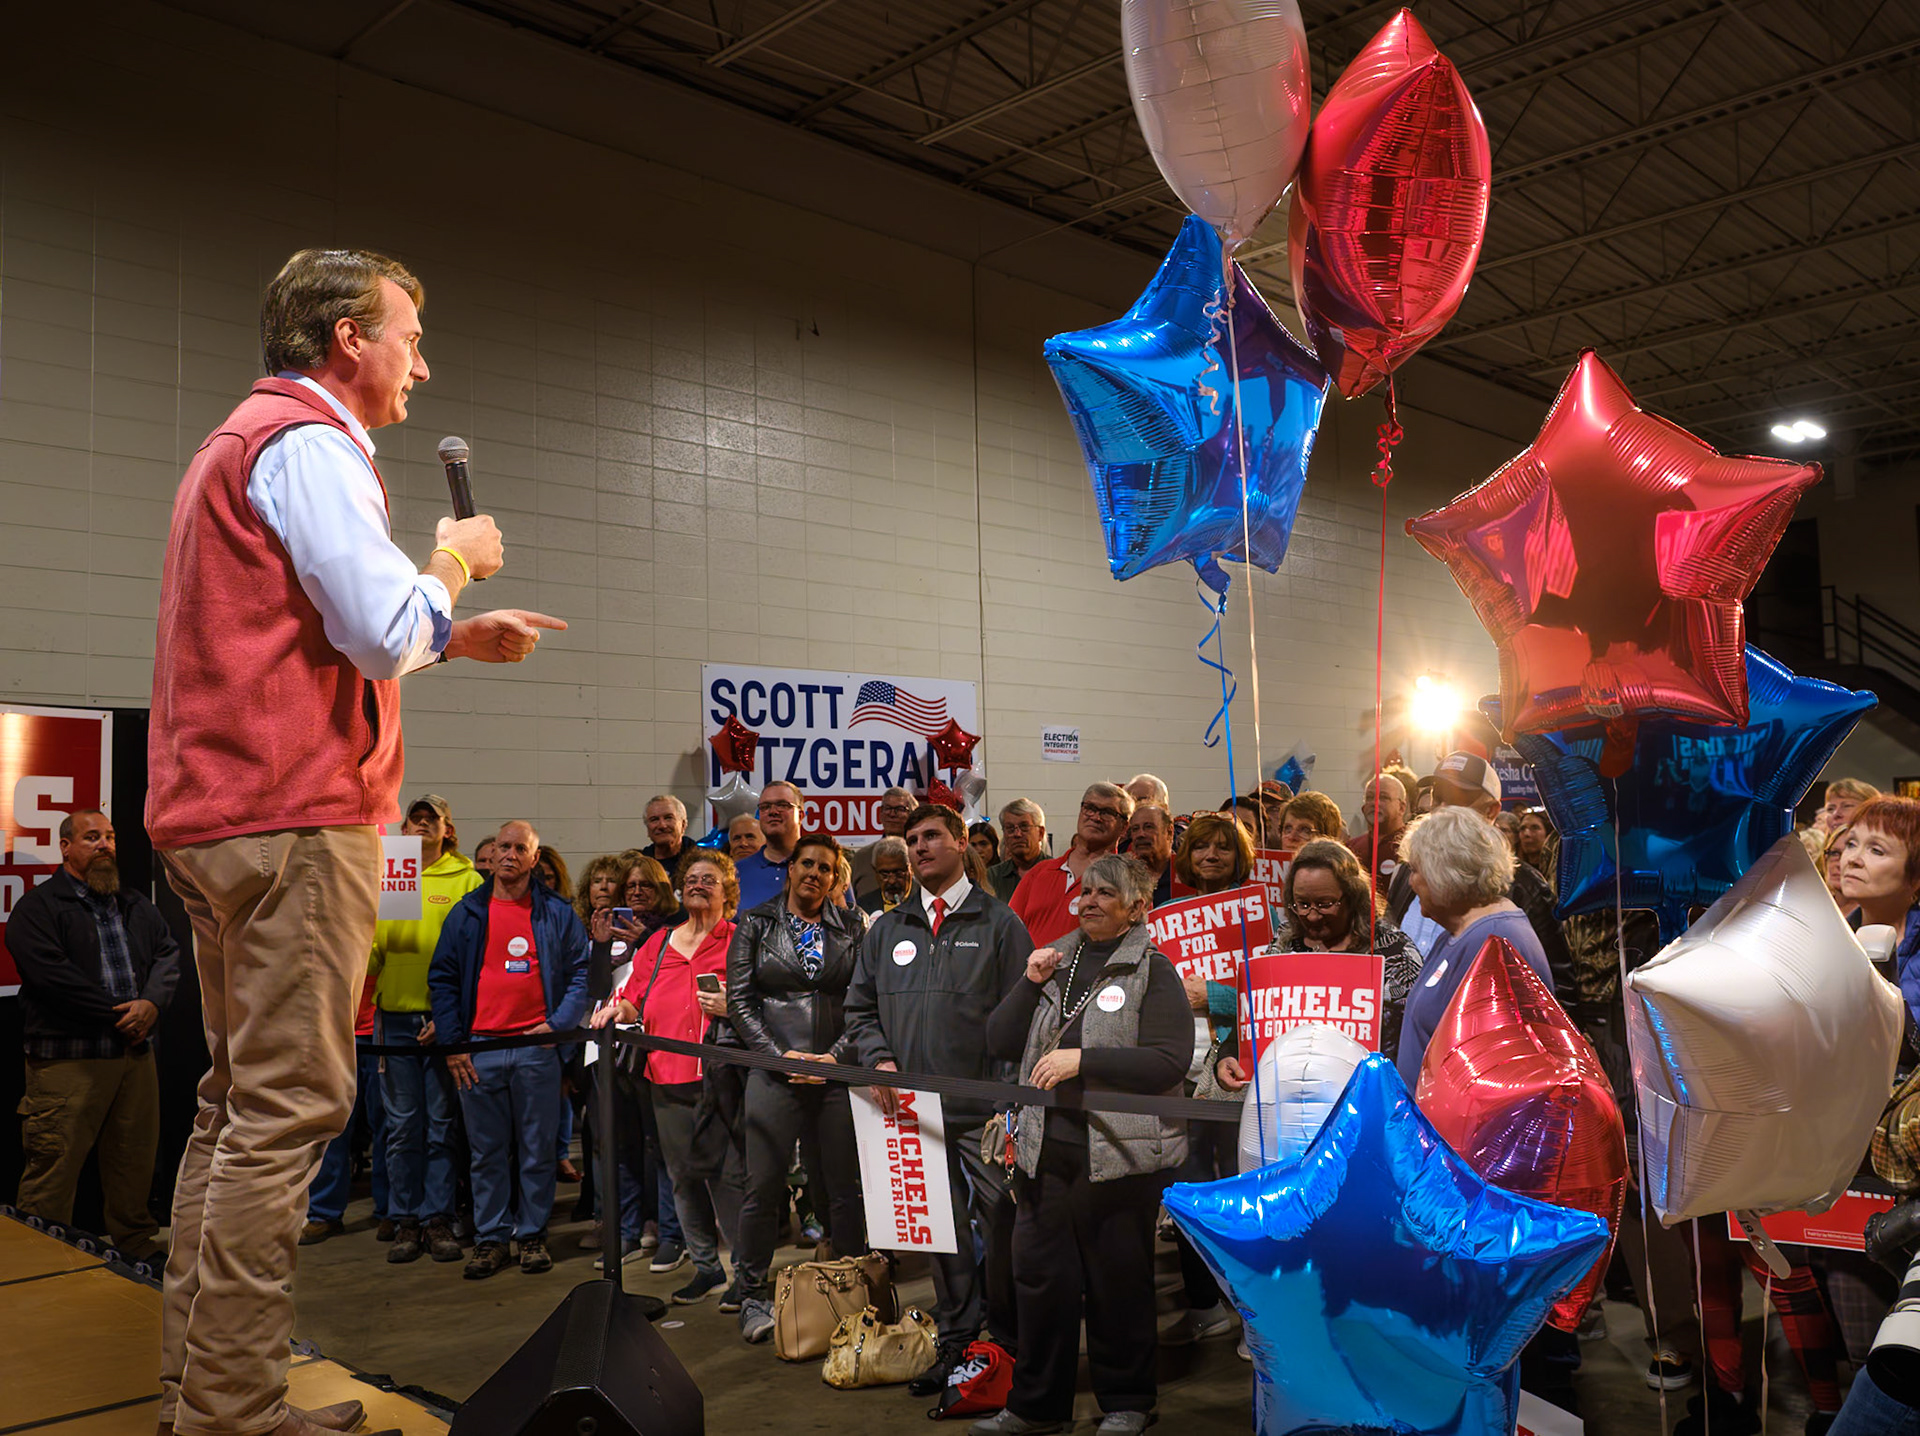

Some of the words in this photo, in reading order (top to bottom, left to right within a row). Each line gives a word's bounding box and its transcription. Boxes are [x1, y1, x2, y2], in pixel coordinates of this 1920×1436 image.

[710, 678, 844, 729] SCOTT
[711, 736, 973, 789] TZGERAL
[1043, 733, 1079, 742] ELECTION
[1145, 895, 1265, 946] PARENTS
[1179, 933, 1218, 958] FOR
[1240, 985, 1375, 1023] MICHELS
[886, 1138, 909, 1243] GOVERNOR
[897, 1091, 932, 1245] MICHELS
